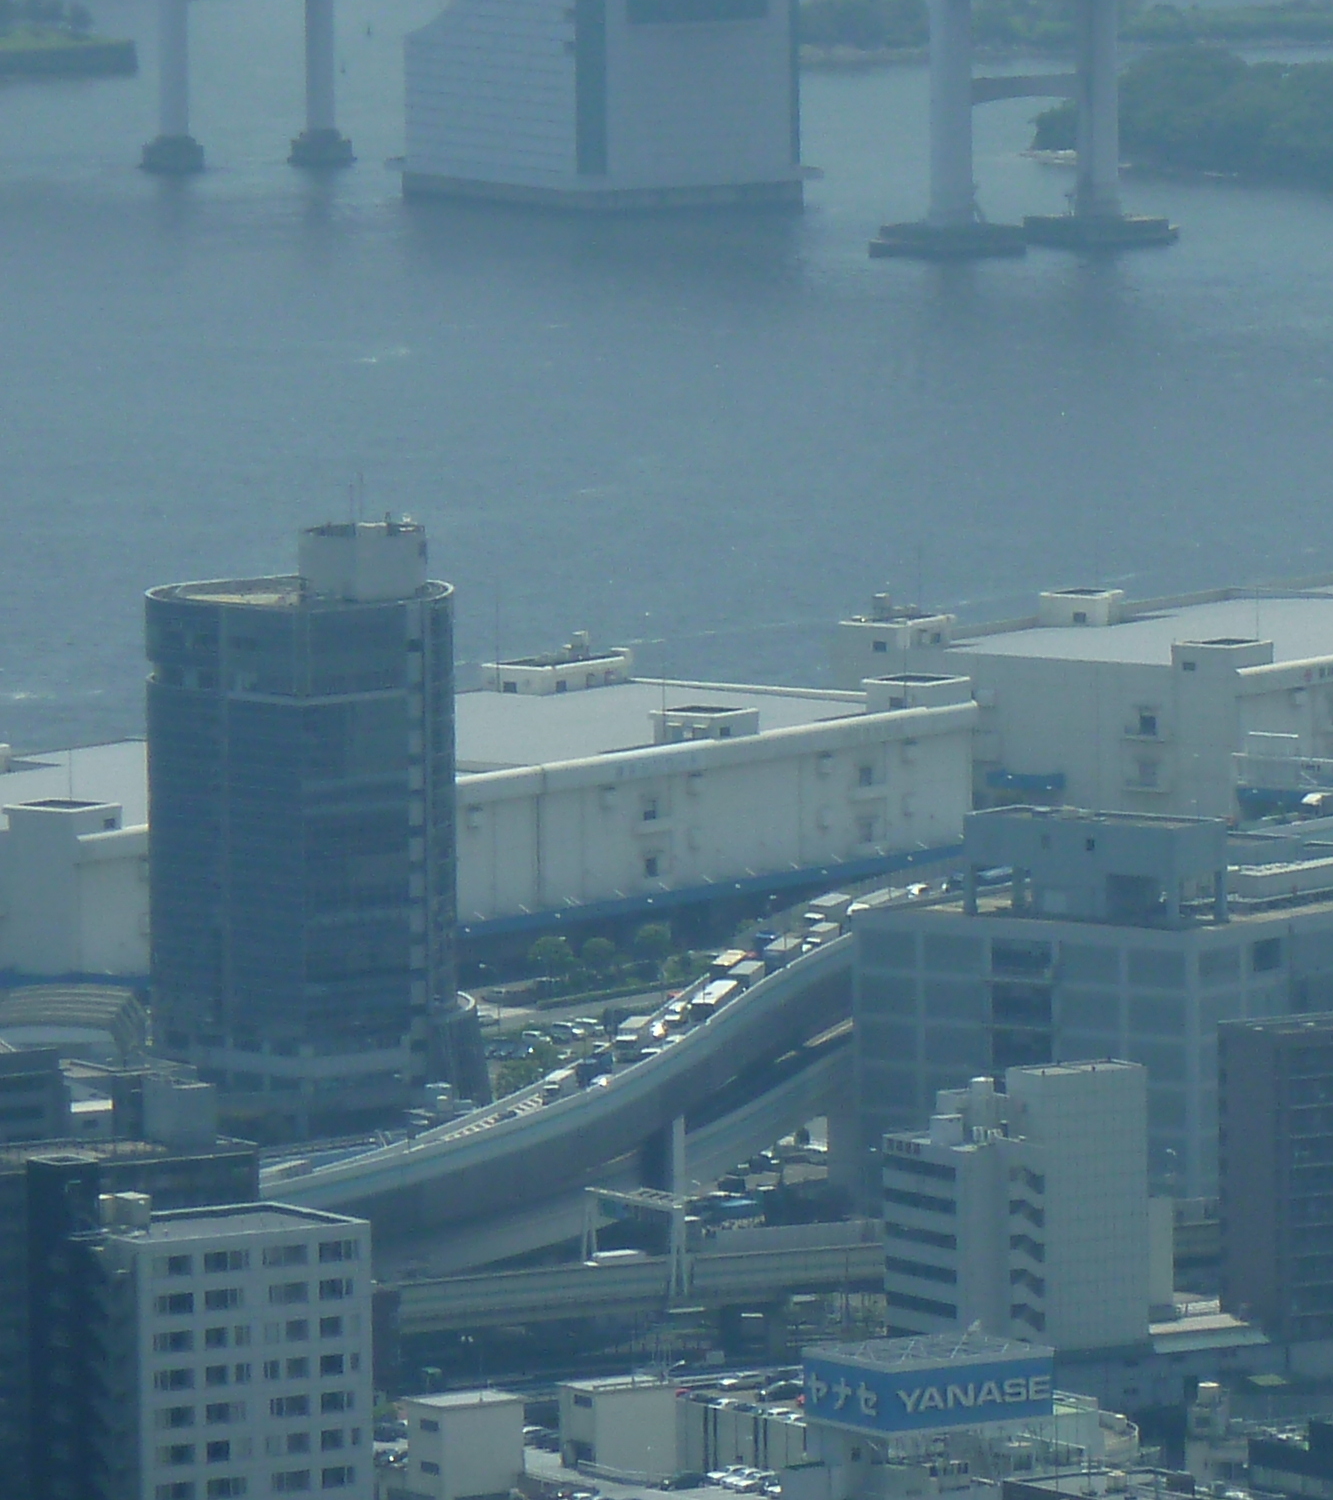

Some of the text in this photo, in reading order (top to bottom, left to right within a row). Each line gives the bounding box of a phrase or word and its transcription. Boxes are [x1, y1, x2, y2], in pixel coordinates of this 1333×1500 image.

[808, 1372, 878, 1417] ヤナセ
[899, 1375, 1051, 1414] YANASE
